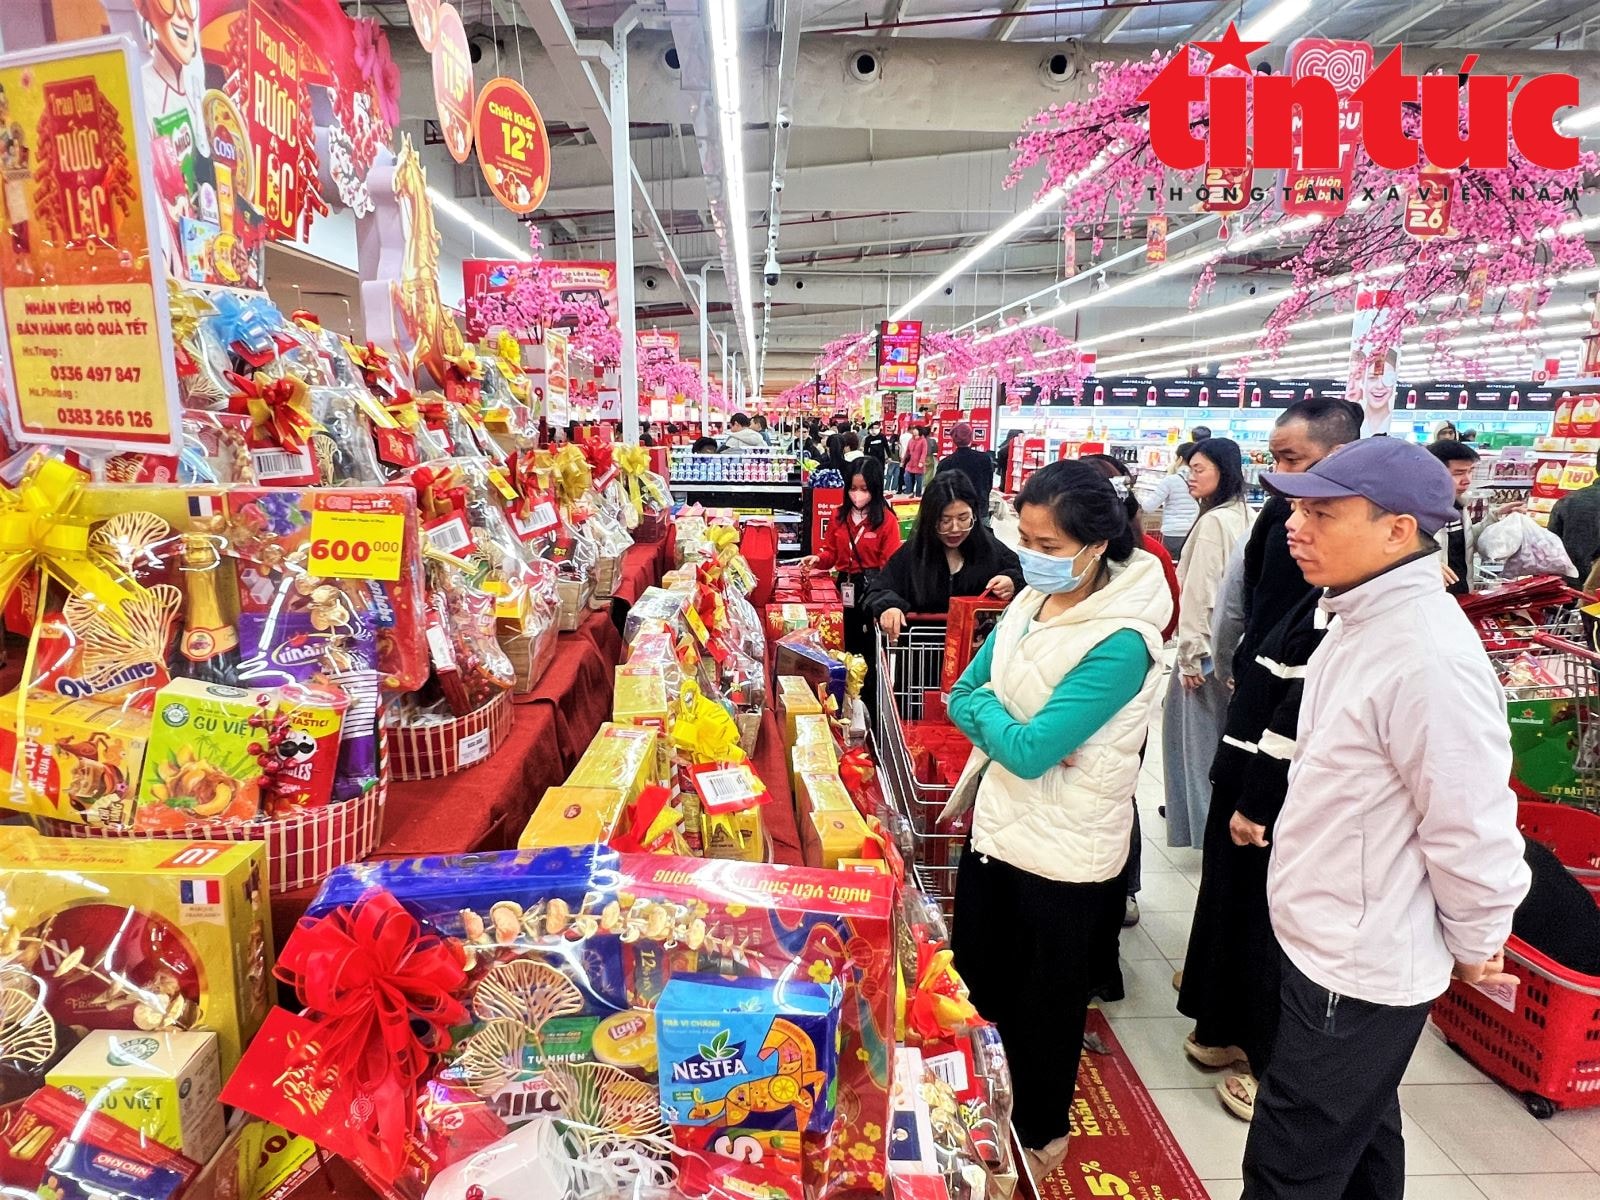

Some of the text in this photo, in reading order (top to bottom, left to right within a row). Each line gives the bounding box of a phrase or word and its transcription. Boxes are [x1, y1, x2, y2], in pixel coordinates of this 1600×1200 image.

[255, 18, 297, 82] Trao Quà
[49, 88, 95, 118] Trao Quà
[254, 70, 297, 148] RƯỚC
[488, 101, 513, 122] Chiết
[55, 120, 103, 173] RƯỚC
[50, 365, 141, 383] 0336 497 847
[602, 400, 614, 411] 47
[58, 408, 153, 428] 0383 266 126
[193, 716, 217, 732] GU
[672, 1059, 749, 1081] NESTEA
